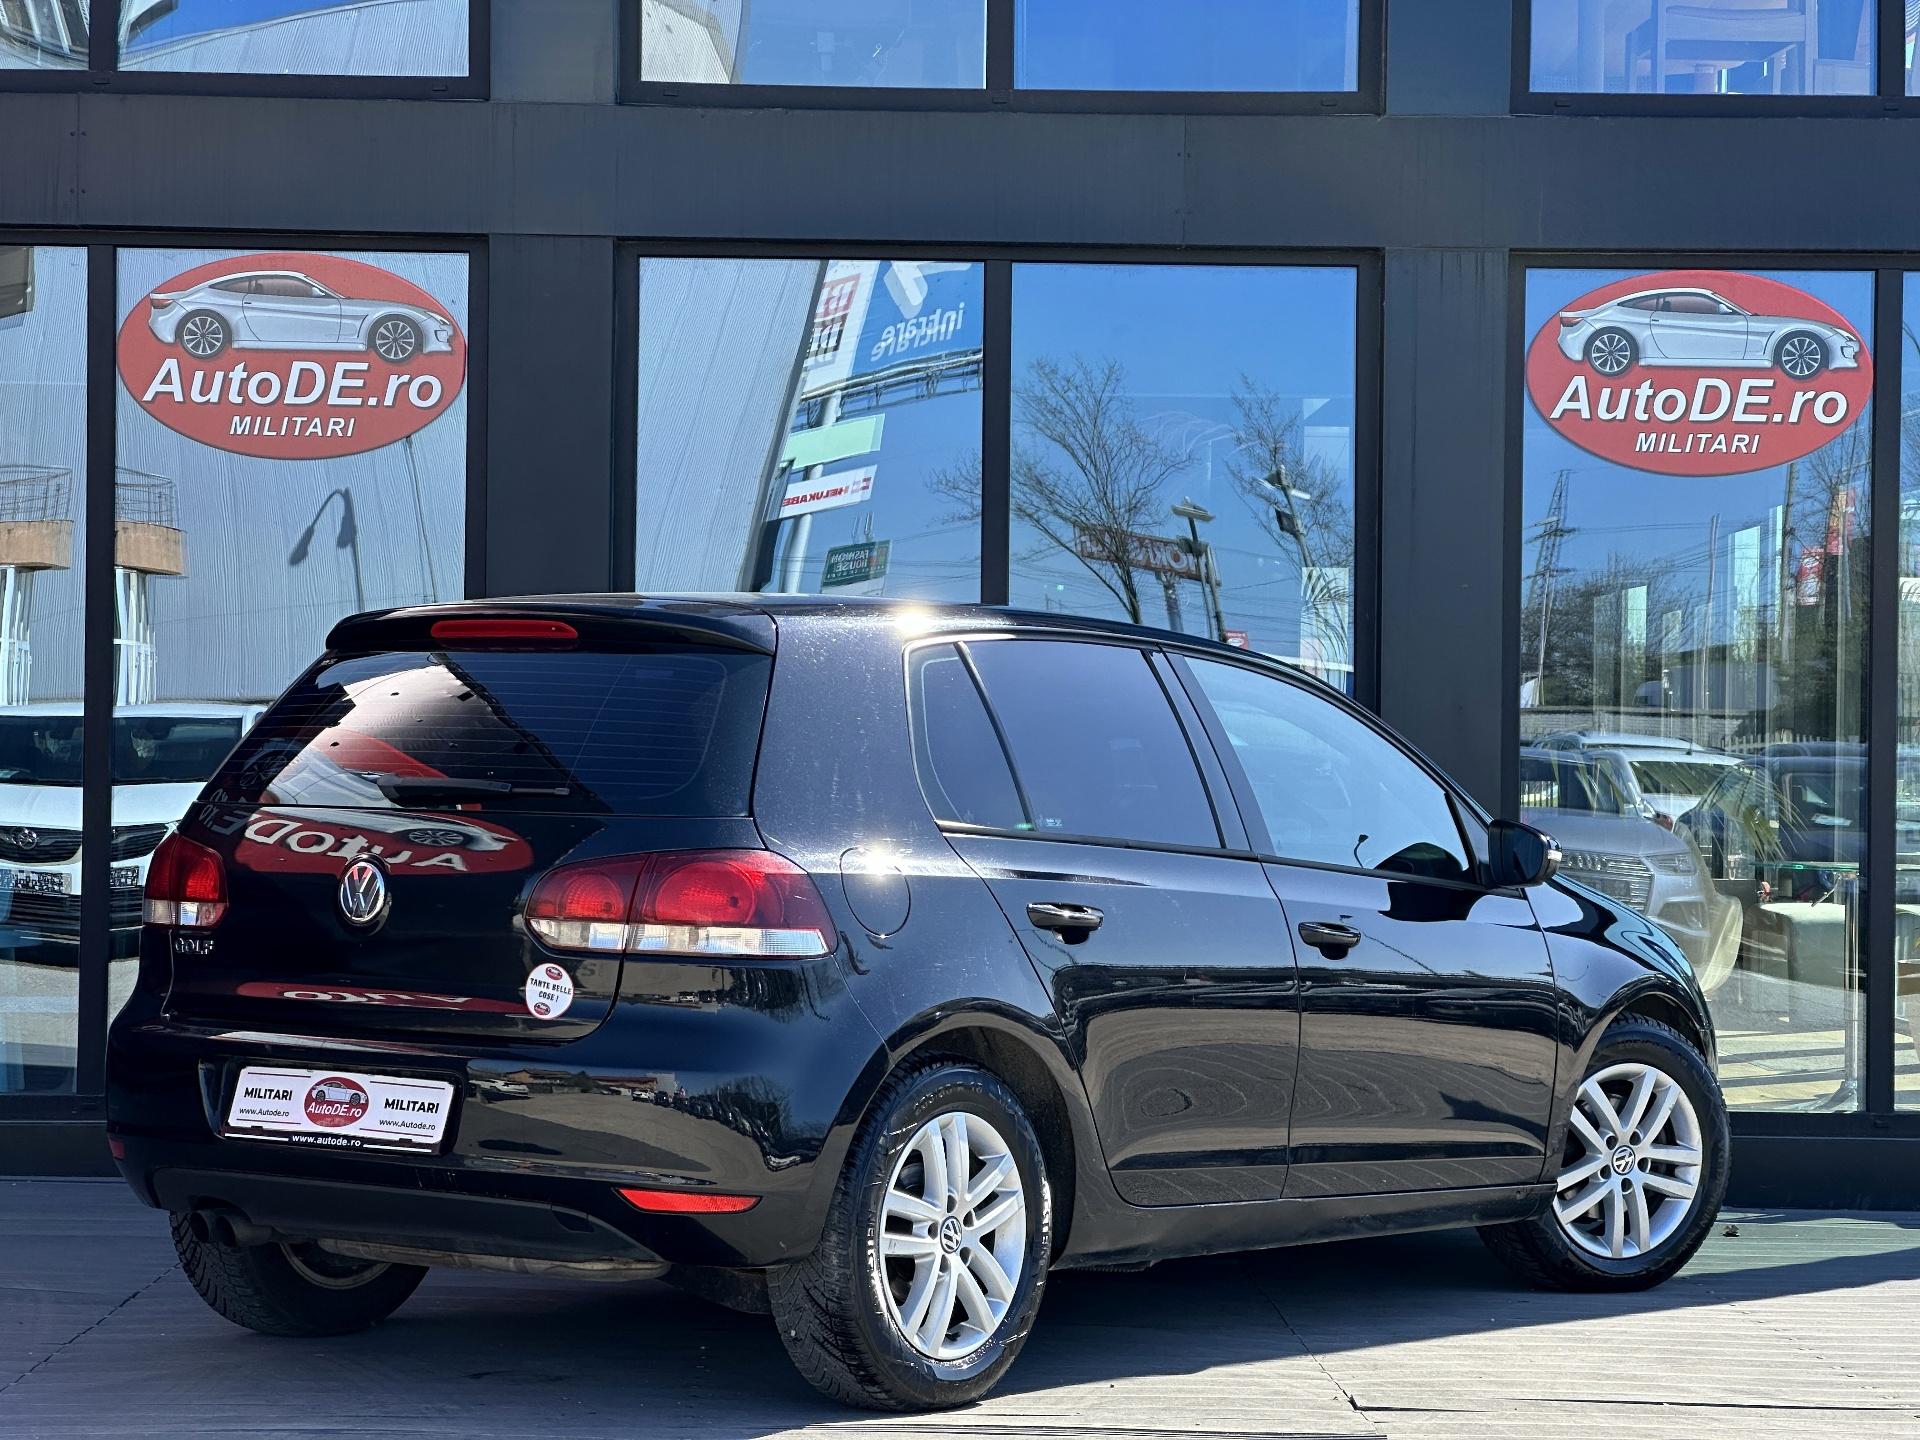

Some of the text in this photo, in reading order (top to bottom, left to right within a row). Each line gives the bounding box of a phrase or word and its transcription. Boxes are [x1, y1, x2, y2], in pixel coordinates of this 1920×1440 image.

[142, 358, 444, 408] AutoDE.ro
[1549, 375, 1848, 425] AutoDE.ro
[229, 415, 356, 438] MILITARI
[1634, 432, 1760, 454] MILITARI
[174, 937, 215, 956] GOLF
[530, 978, 572, 995] TANTE BELLE
[538, 991, 555, 1001] COSE
[243, 1086, 293, 1102] MILITARI
[239, 1107, 290, 1118] www.Autode.ro
[307, 1102, 363, 1119] AutoDE.ro
[384, 1098, 440, 1114] MILITARI
[379, 1117, 437, 1132] www.Autode.ro
[291, 1134, 362, 1148] www.autode.ro
